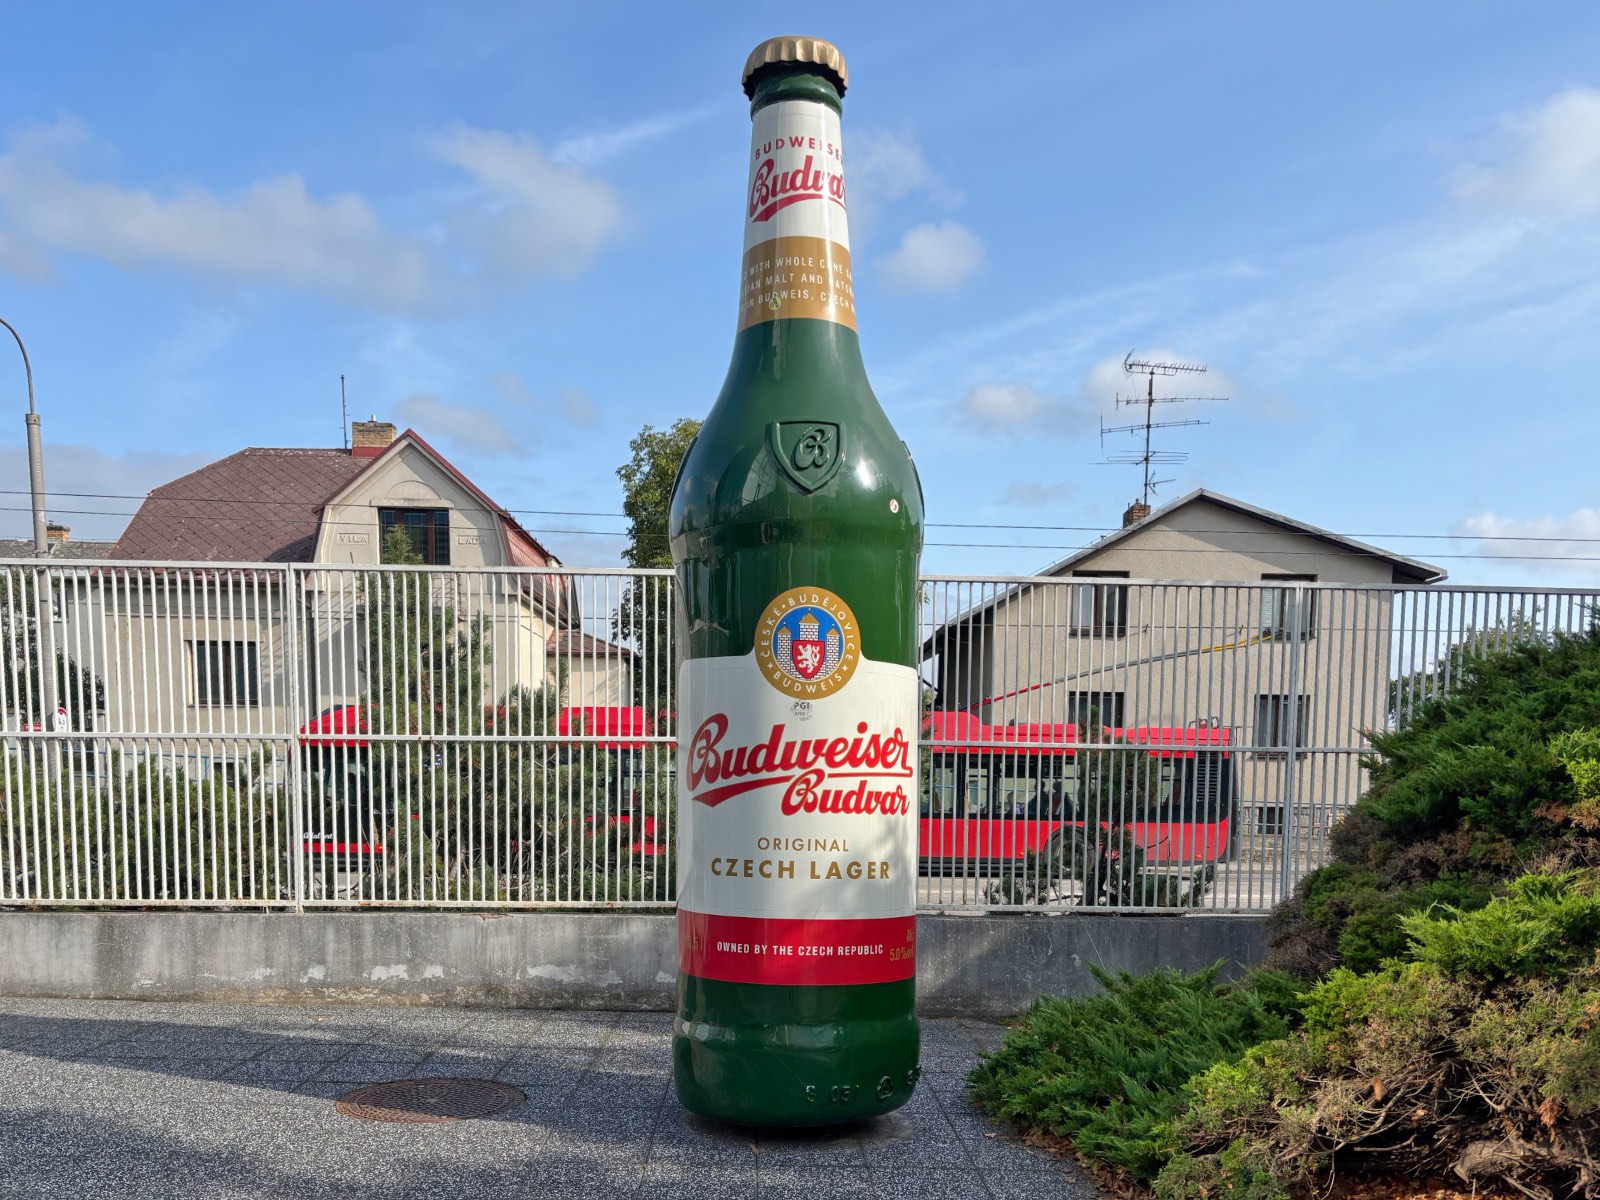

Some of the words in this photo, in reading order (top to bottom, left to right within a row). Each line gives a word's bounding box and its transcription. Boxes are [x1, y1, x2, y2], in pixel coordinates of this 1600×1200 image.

[754, 136, 842, 164] BUDWEISE
[750, 259, 770, 276] WITH
[776, 256, 814, 269] WHOLE
[819, 258, 843, 275] CNE
[766, 273, 795, 286] MALT
[801, 273, 823, 285] AND
[338, 533, 368, 545] VILA
[761, 607, 782, 658] ČESKÉ
[788, 594, 855, 661] BUDĚJOVICE
[773, 671, 842, 693] BUDWEIS
[794, 701, 810, 710] PGI
[686, 713, 913, 793] Budweiser
[780, 768, 910, 816] Budvar
[757, 837, 849, 852] ORIGINAL
[711, 857, 795, 880] CZECH
[810, 860, 890, 880] LAGER
[717, 941, 750, 954] OWNED
[754, 944, 768, 955] BY
[773, 945, 794, 956] THE
[798, 945, 834, 956] CZECH
[837, 944, 884, 956] REPUBLIC
